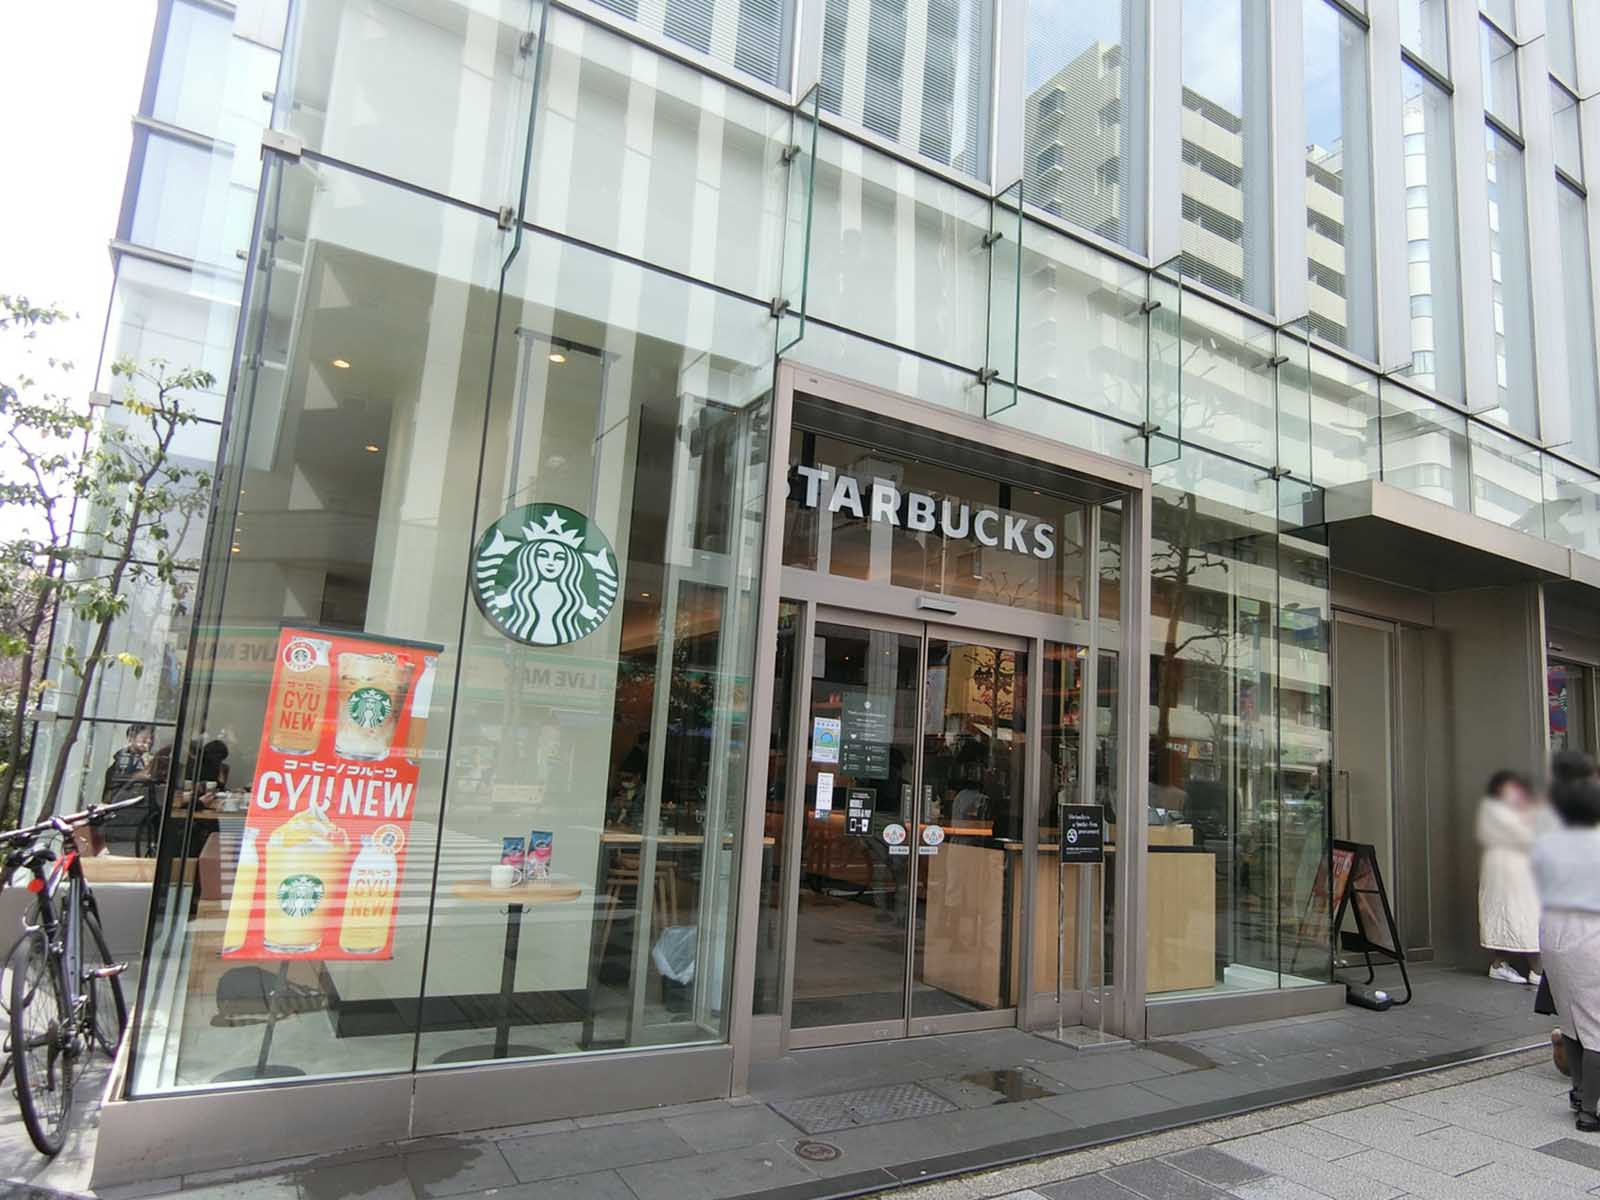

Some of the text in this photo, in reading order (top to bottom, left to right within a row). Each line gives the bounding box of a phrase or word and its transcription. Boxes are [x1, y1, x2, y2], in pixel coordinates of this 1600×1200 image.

[283, 690, 320, 712] GYU
[280, 711, 318, 731] NEW
[256, 770, 414, 818] GYU NEW
